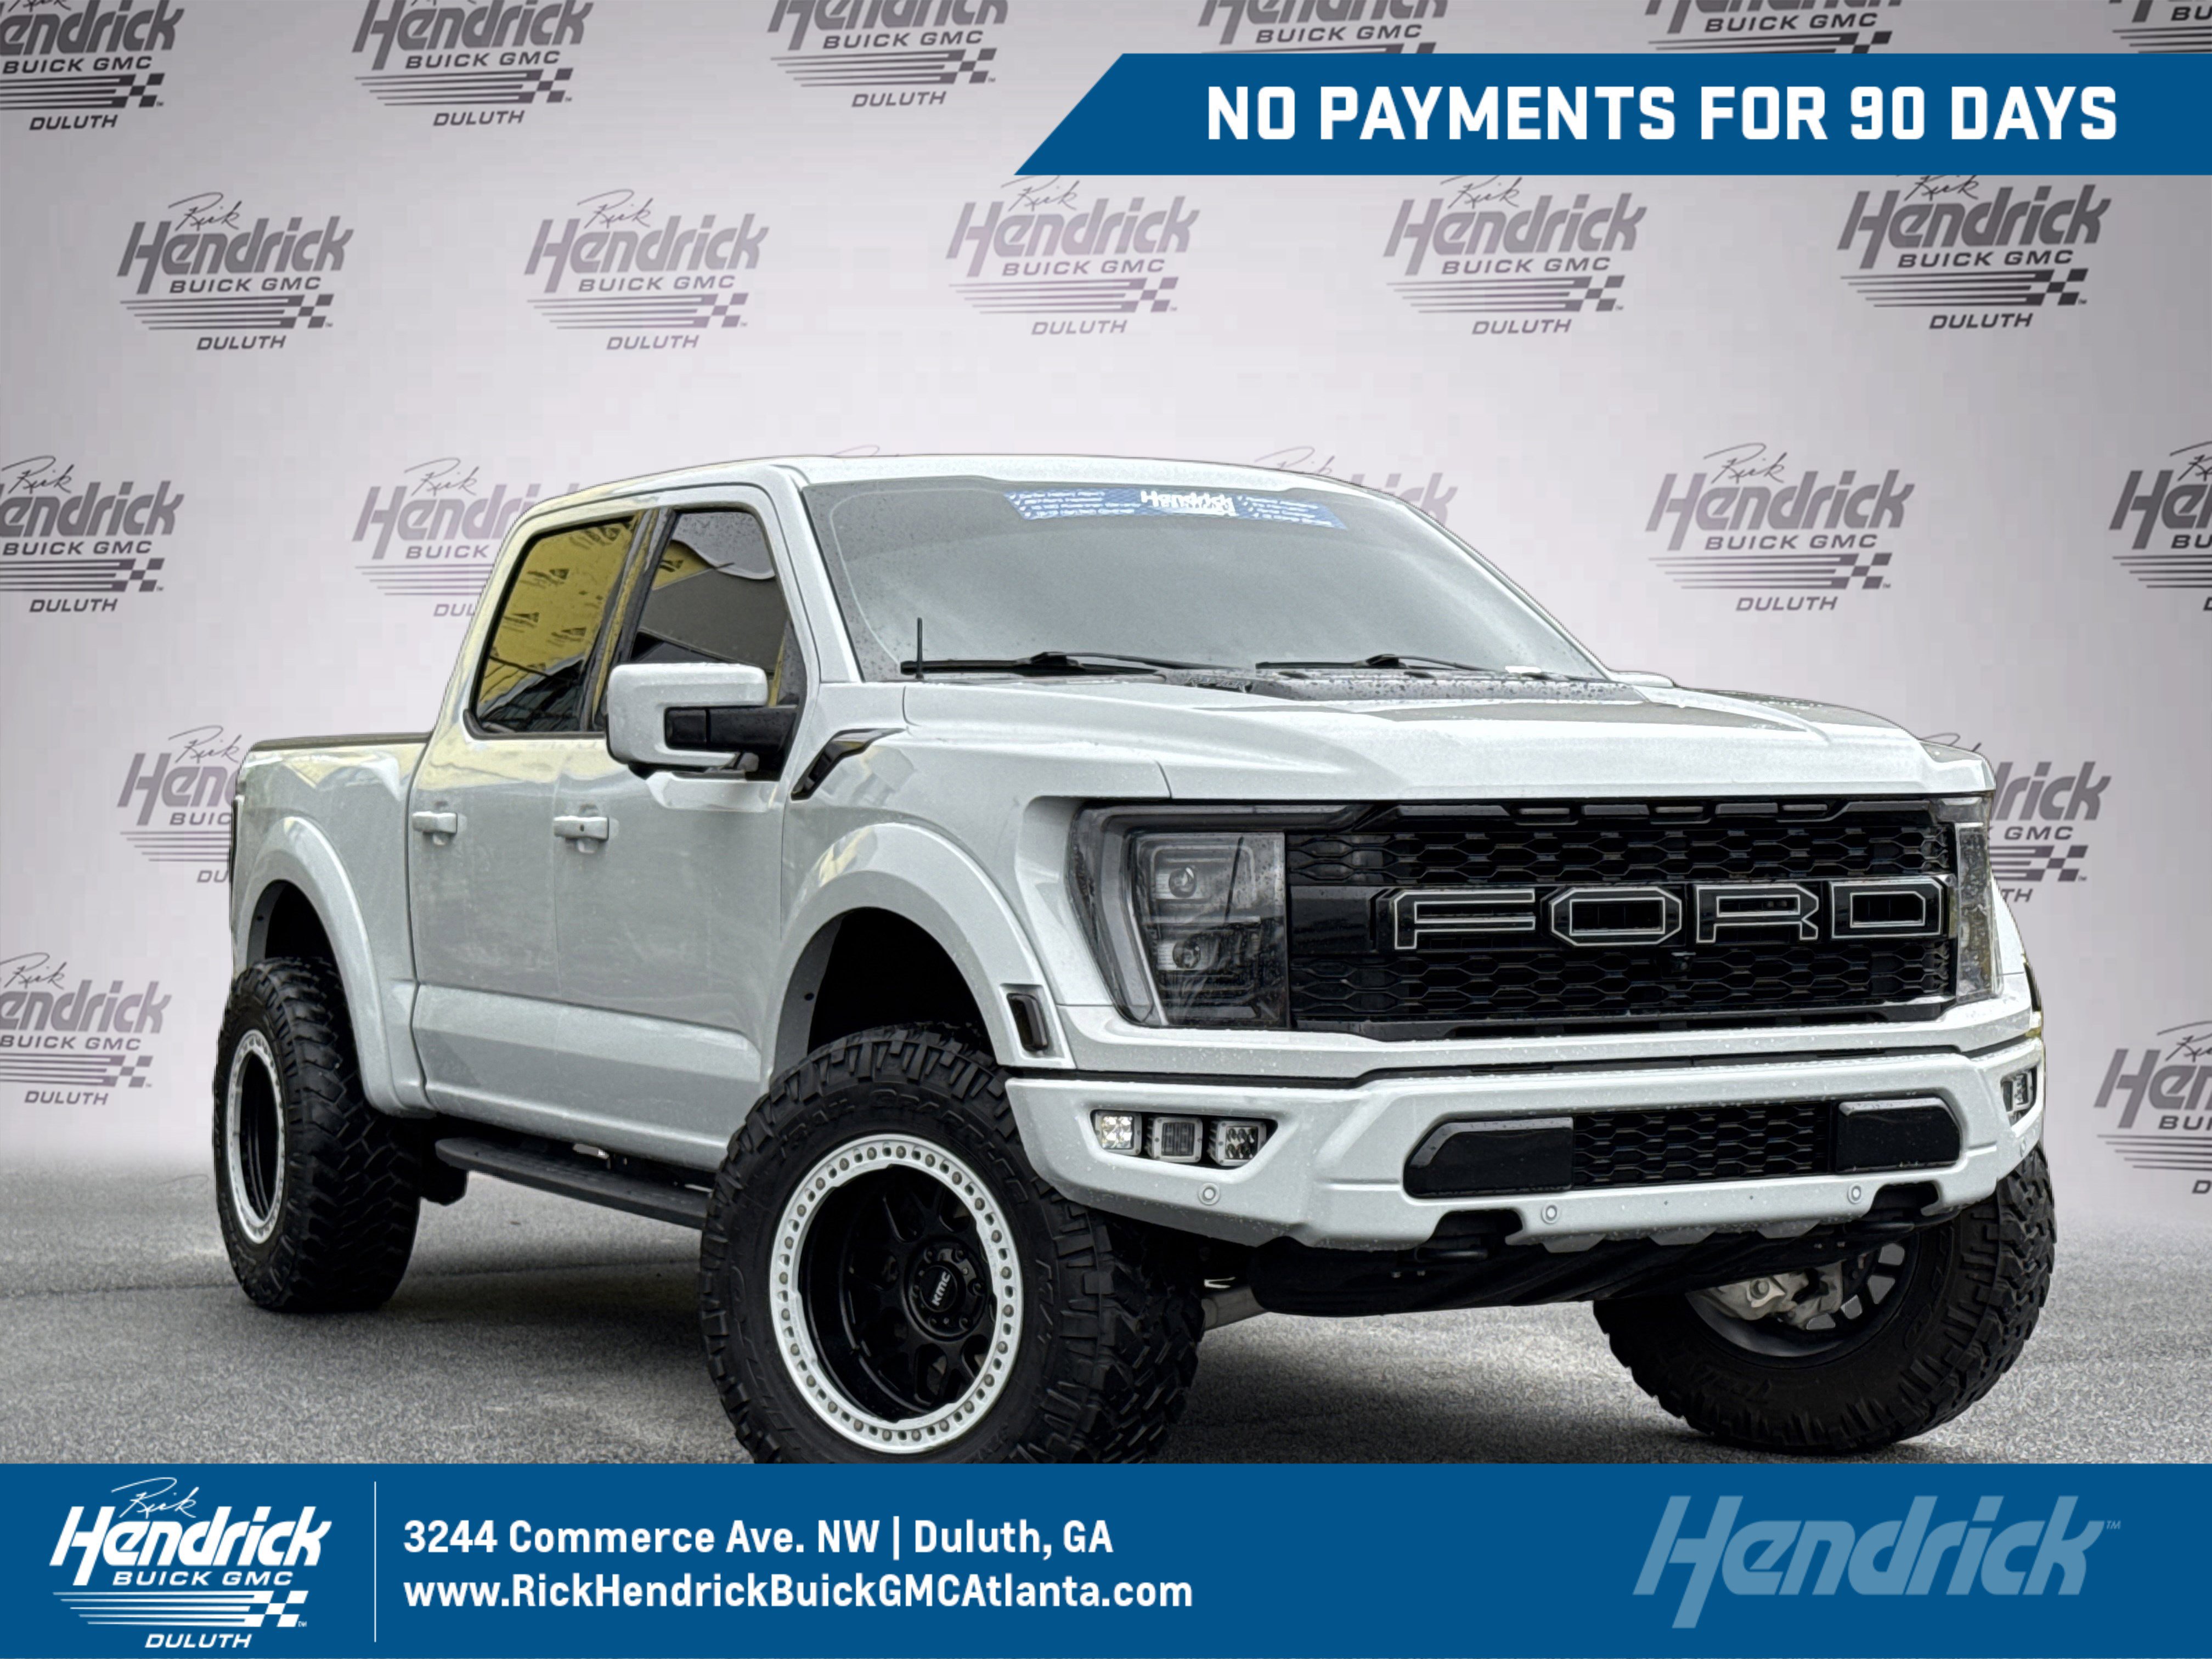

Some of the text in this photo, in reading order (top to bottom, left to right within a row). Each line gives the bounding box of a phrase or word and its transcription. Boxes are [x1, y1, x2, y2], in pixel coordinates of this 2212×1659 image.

[0, 0, 184, 56] endrick
[1705, 15, 1799, 33] BUICK
[1809, 13, 1878, 29] GMC
[823, 30, 984, 49] BUICK GMC
[1256, 25, 1423, 44] BUICK GMC
[3, 56, 153, 74] BUICK GMC
[405, 50, 561, 69] BUICK GMC
[851, 91, 946, 108] DULUTH
[30, 114, 118, 130] DULUTH
[433, 110, 525, 126] DULUTH
[1383, 193, 1647, 276] Hendrick
[1837, 184, 2112, 269] Hendrick
[945, 196, 1200, 278] Hendrick
[117, 216, 354, 295] Hendrick
[524, 213, 769, 294] Hendrick
[1898, 249, 2074, 268] BUICK GMC
[1002, 258, 1165, 276] BUICK GMC
[1441, 256, 1611, 275] BUICK GMC
[169, 276, 321, 294] BUICK GMC
[578, 275, 736, 292] BUICK GMC
[1031, 319, 1128, 335] DULUTH
[1472, 318, 1572, 335] DULUTH
[1929, 312, 2034, 329] DULUTH
[196, 335, 286, 350] DULUTH
[606, 335, 699, 350] DULUTH
[0, 481, 184, 538] endrick
[1645, 470, 1915, 551] Hendrick
[3, 541, 153, 556] BUICK GMC
[1704, 534, 1878, 550] BUICK GMC
[405, 545, 489, 559] BUICK
[30, 598, 118, 613] DULUTH
[1735, 595, 1838, 612] DULUTH
[169, 812, 232, 826] BUIC
[2004, 826, 2074, 840] GMC
[1391, 879, 1942, 951] FORD
[0, 979, 172, 1034] endrick
[0, 1035, 142, 1051] BUICK GMC
[24, 1091, 109, 1105] DULUTH
[932, 1271, 951, 1306] KMC
